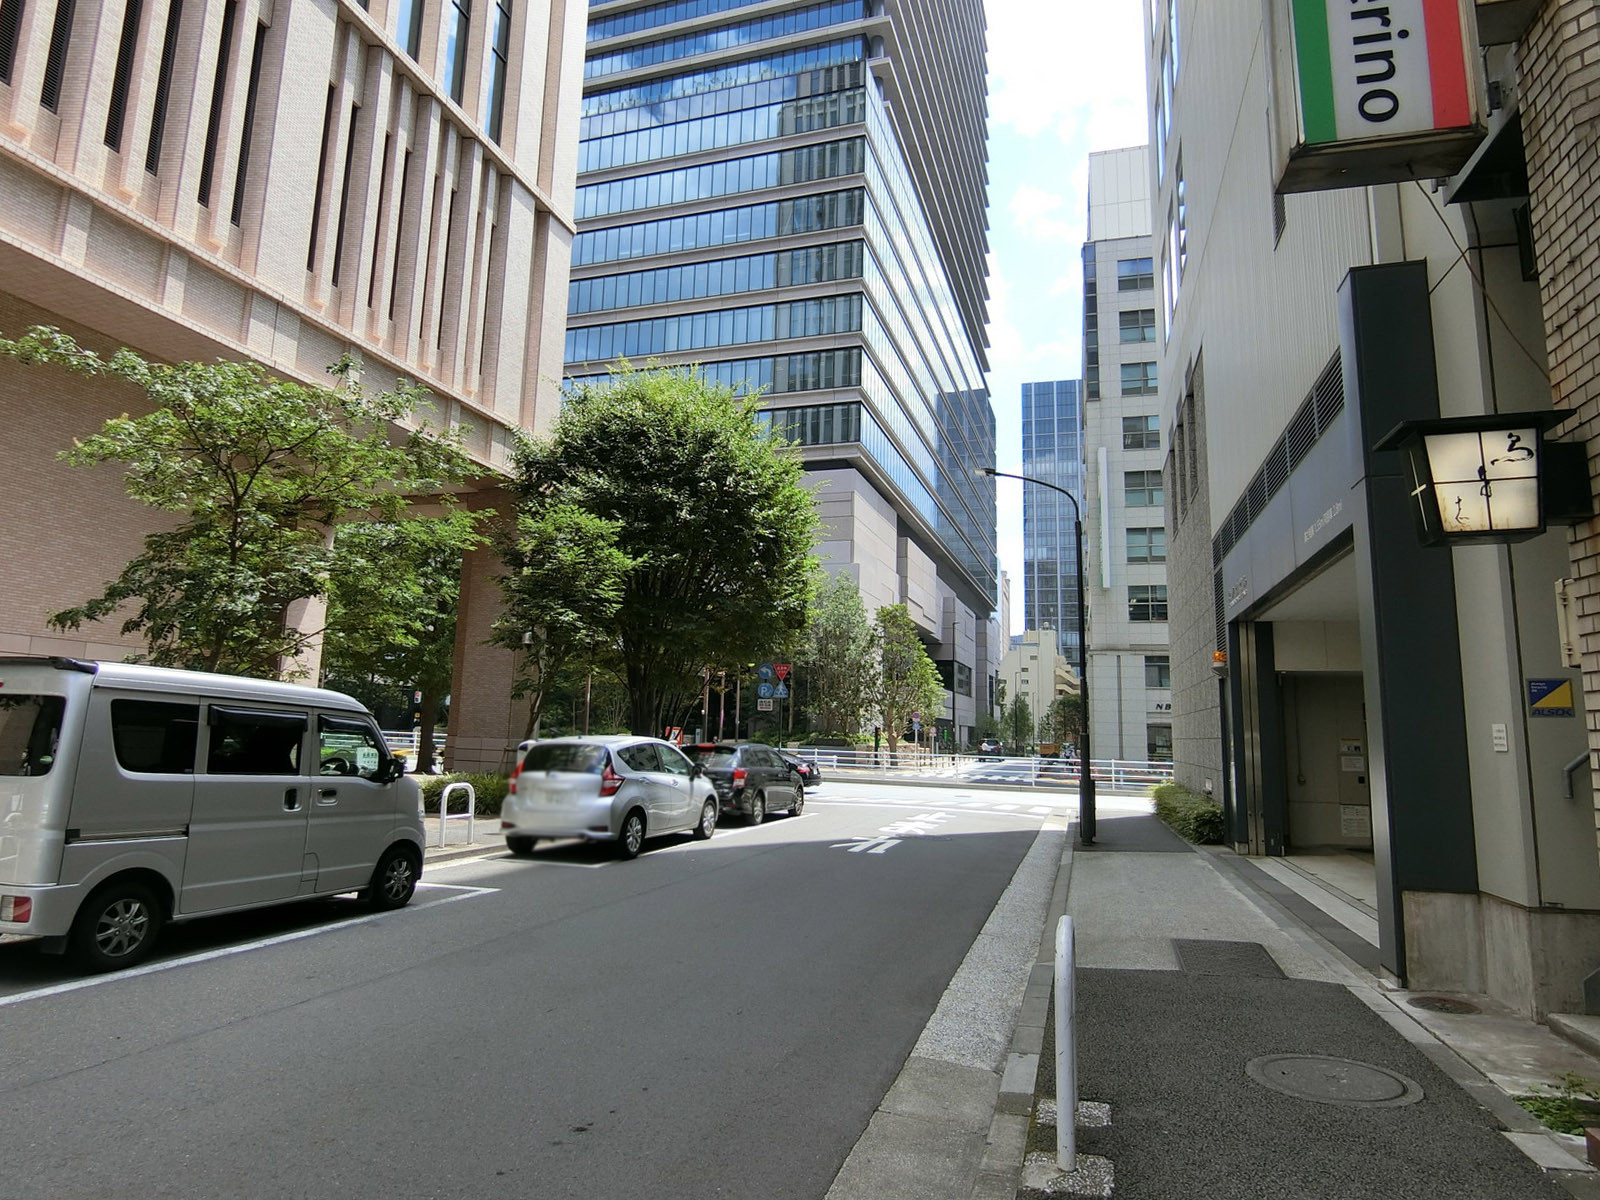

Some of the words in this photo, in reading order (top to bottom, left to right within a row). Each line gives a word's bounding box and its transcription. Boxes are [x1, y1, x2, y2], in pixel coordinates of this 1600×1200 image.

[1351, 0, 1409, 122] rino
[829, 812, 957, 853] 止まれ
